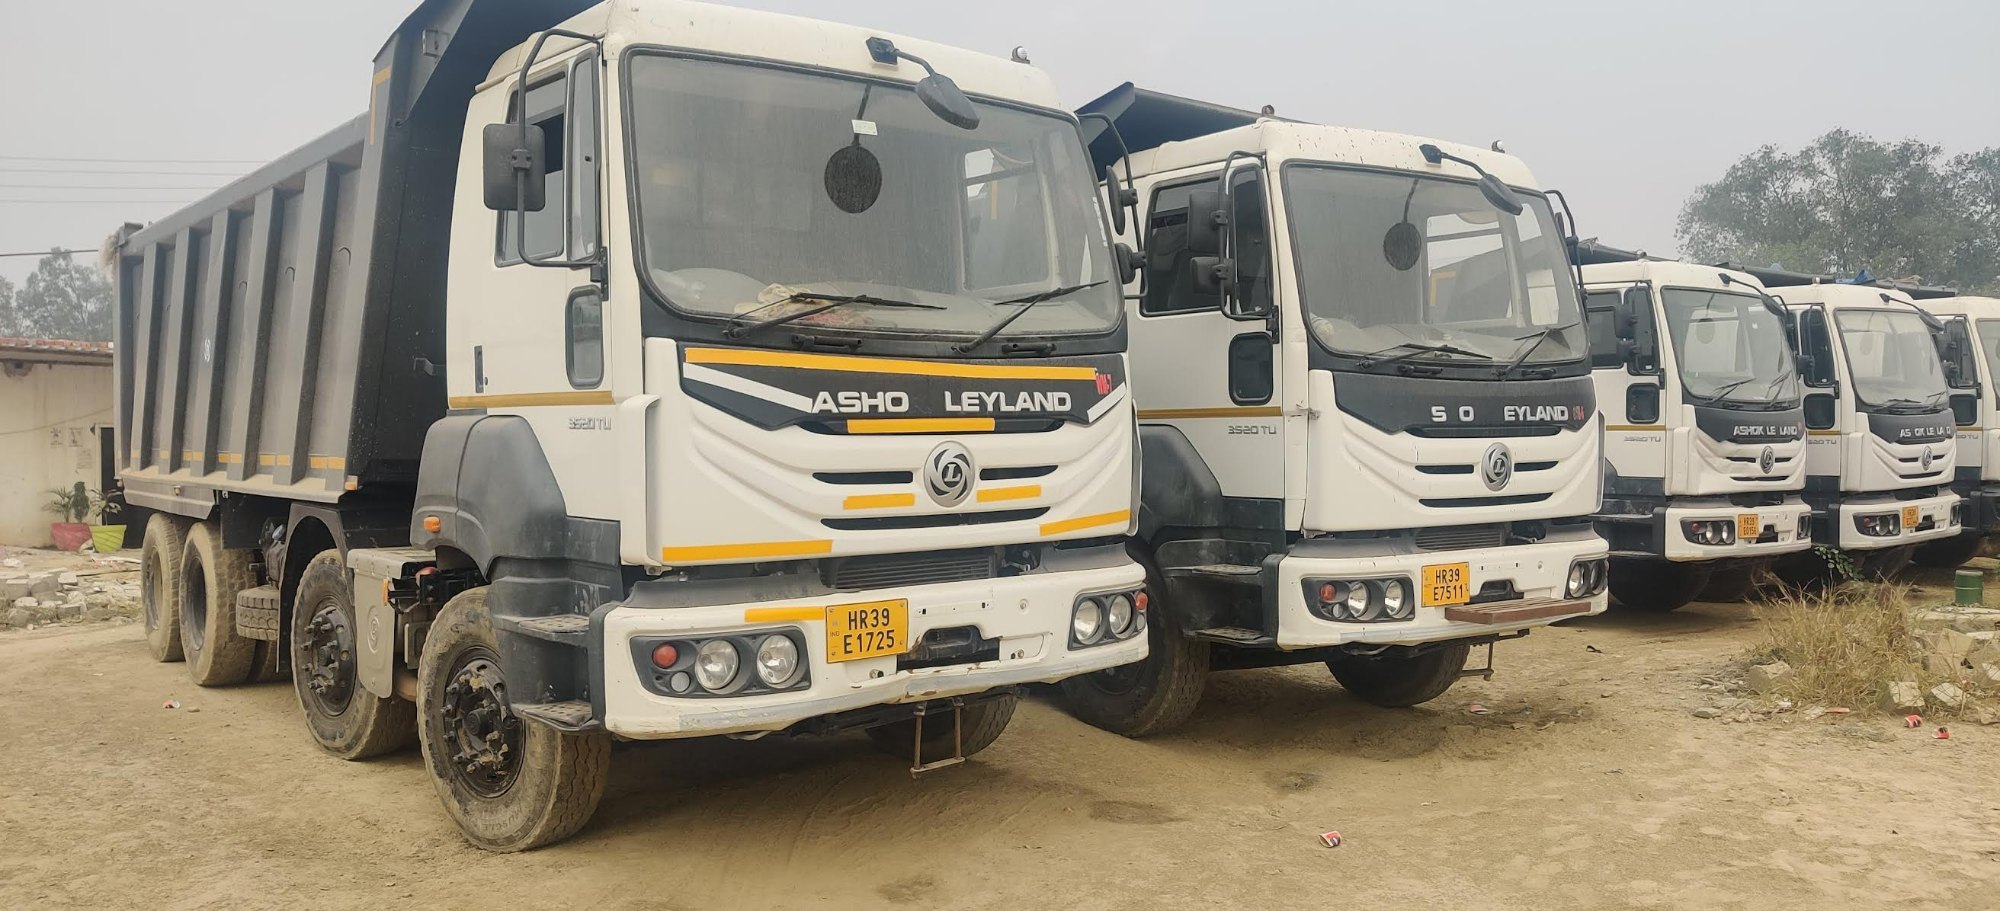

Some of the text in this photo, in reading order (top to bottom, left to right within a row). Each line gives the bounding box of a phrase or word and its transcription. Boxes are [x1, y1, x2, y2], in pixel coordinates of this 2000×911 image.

[811, 390, 1072, 414] ASHO LEYLAND
[1504, 405, 1569, 422] EYLAND
[1228, 425, 1277, 435] 3520 TU
[1733, 425, 1765, 436] ASHOK
[1435, 568, 1460, 584] HR39
[1433, 584, 1463, 601] E7511
[848, 608, 890, 630] HR39
[843, 629, 895, 654] E1725
